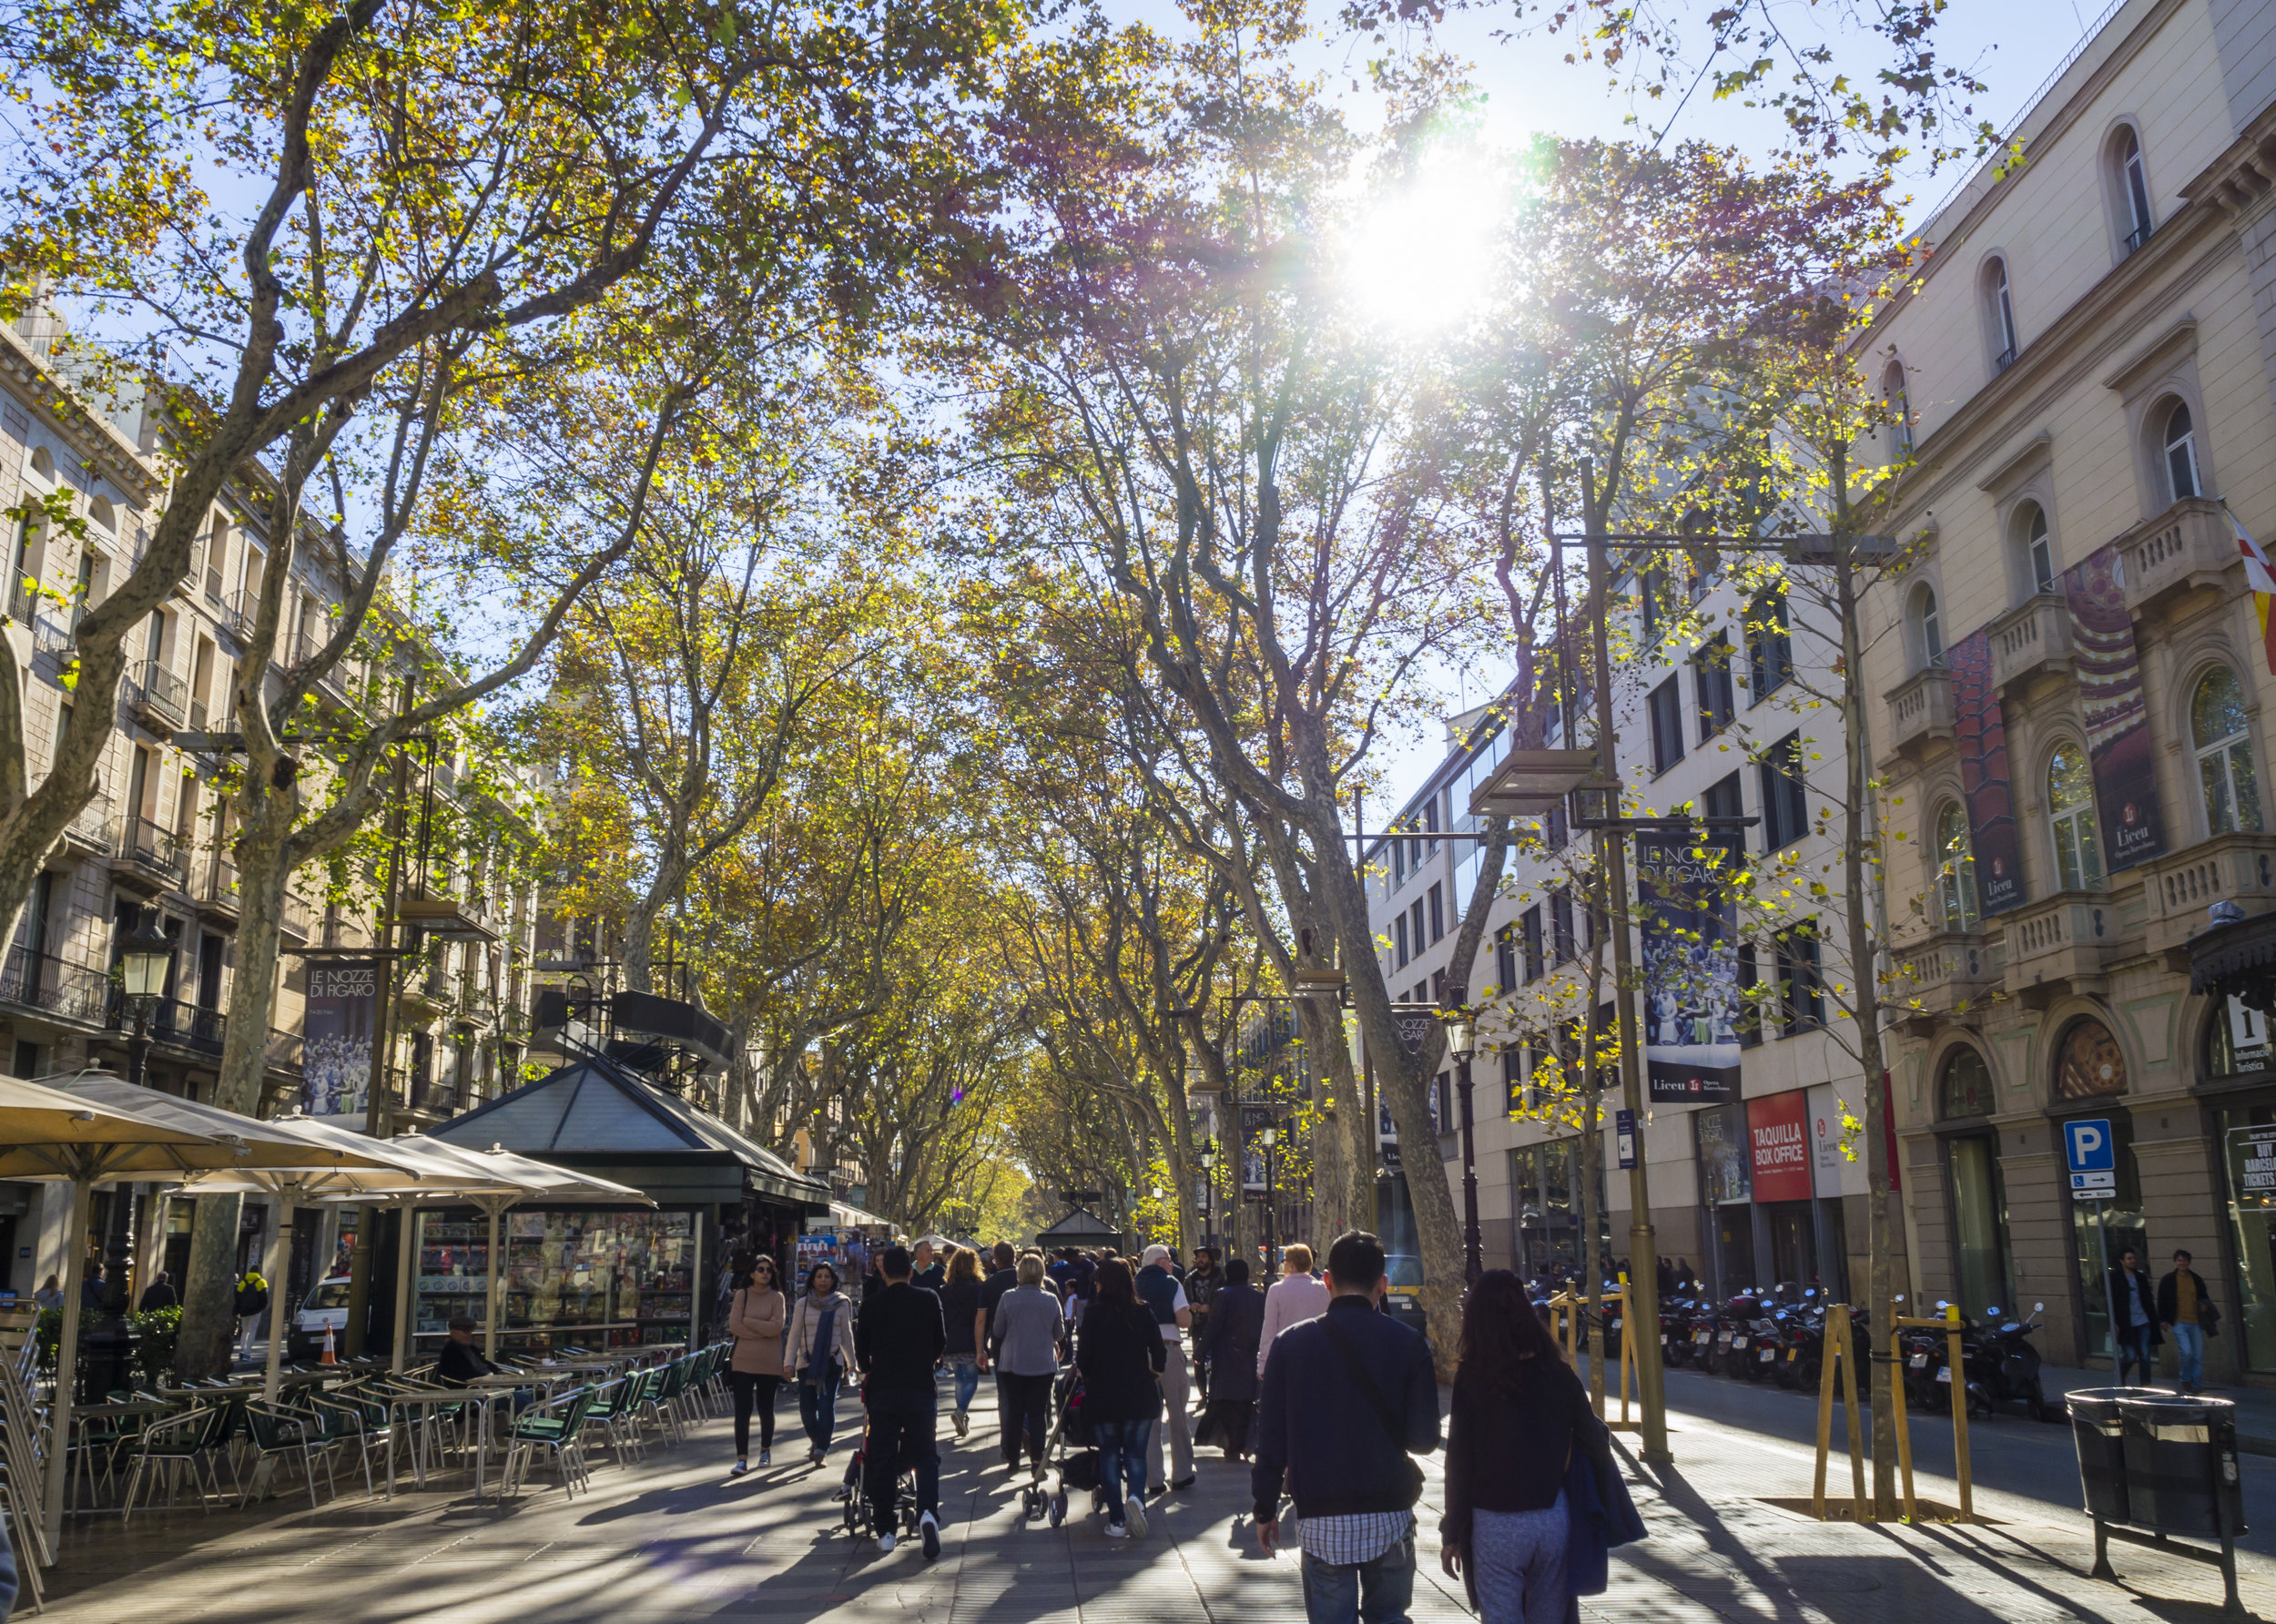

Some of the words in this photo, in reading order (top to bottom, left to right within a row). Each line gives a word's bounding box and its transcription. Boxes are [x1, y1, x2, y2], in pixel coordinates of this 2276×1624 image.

[2117, 827, 2149, 847] Liceu
[1644, 846, 1658, 863] LE
[1665, 847, 1726, 864] NOZ
[311, 970, 323, 983] LE
[328, 969, 374, 983] NOZZE
[310, 985, 323, 998] DI
[328, 983, 375, 997] FIGARO
[1653, 1079, 1686, 1091] Liceu
[1753, 1122, 1802, 1146] TAQUILLA
[2074, 1126, 2102, 1165] P
[2257, 1142, 2272, 1158] BUY
[1755, 1148, 1773, 1166] BOX
[1773, 1144, 1804, 1164] OFFICE
[2243, 1172, 2275, 1187] TICKETS
